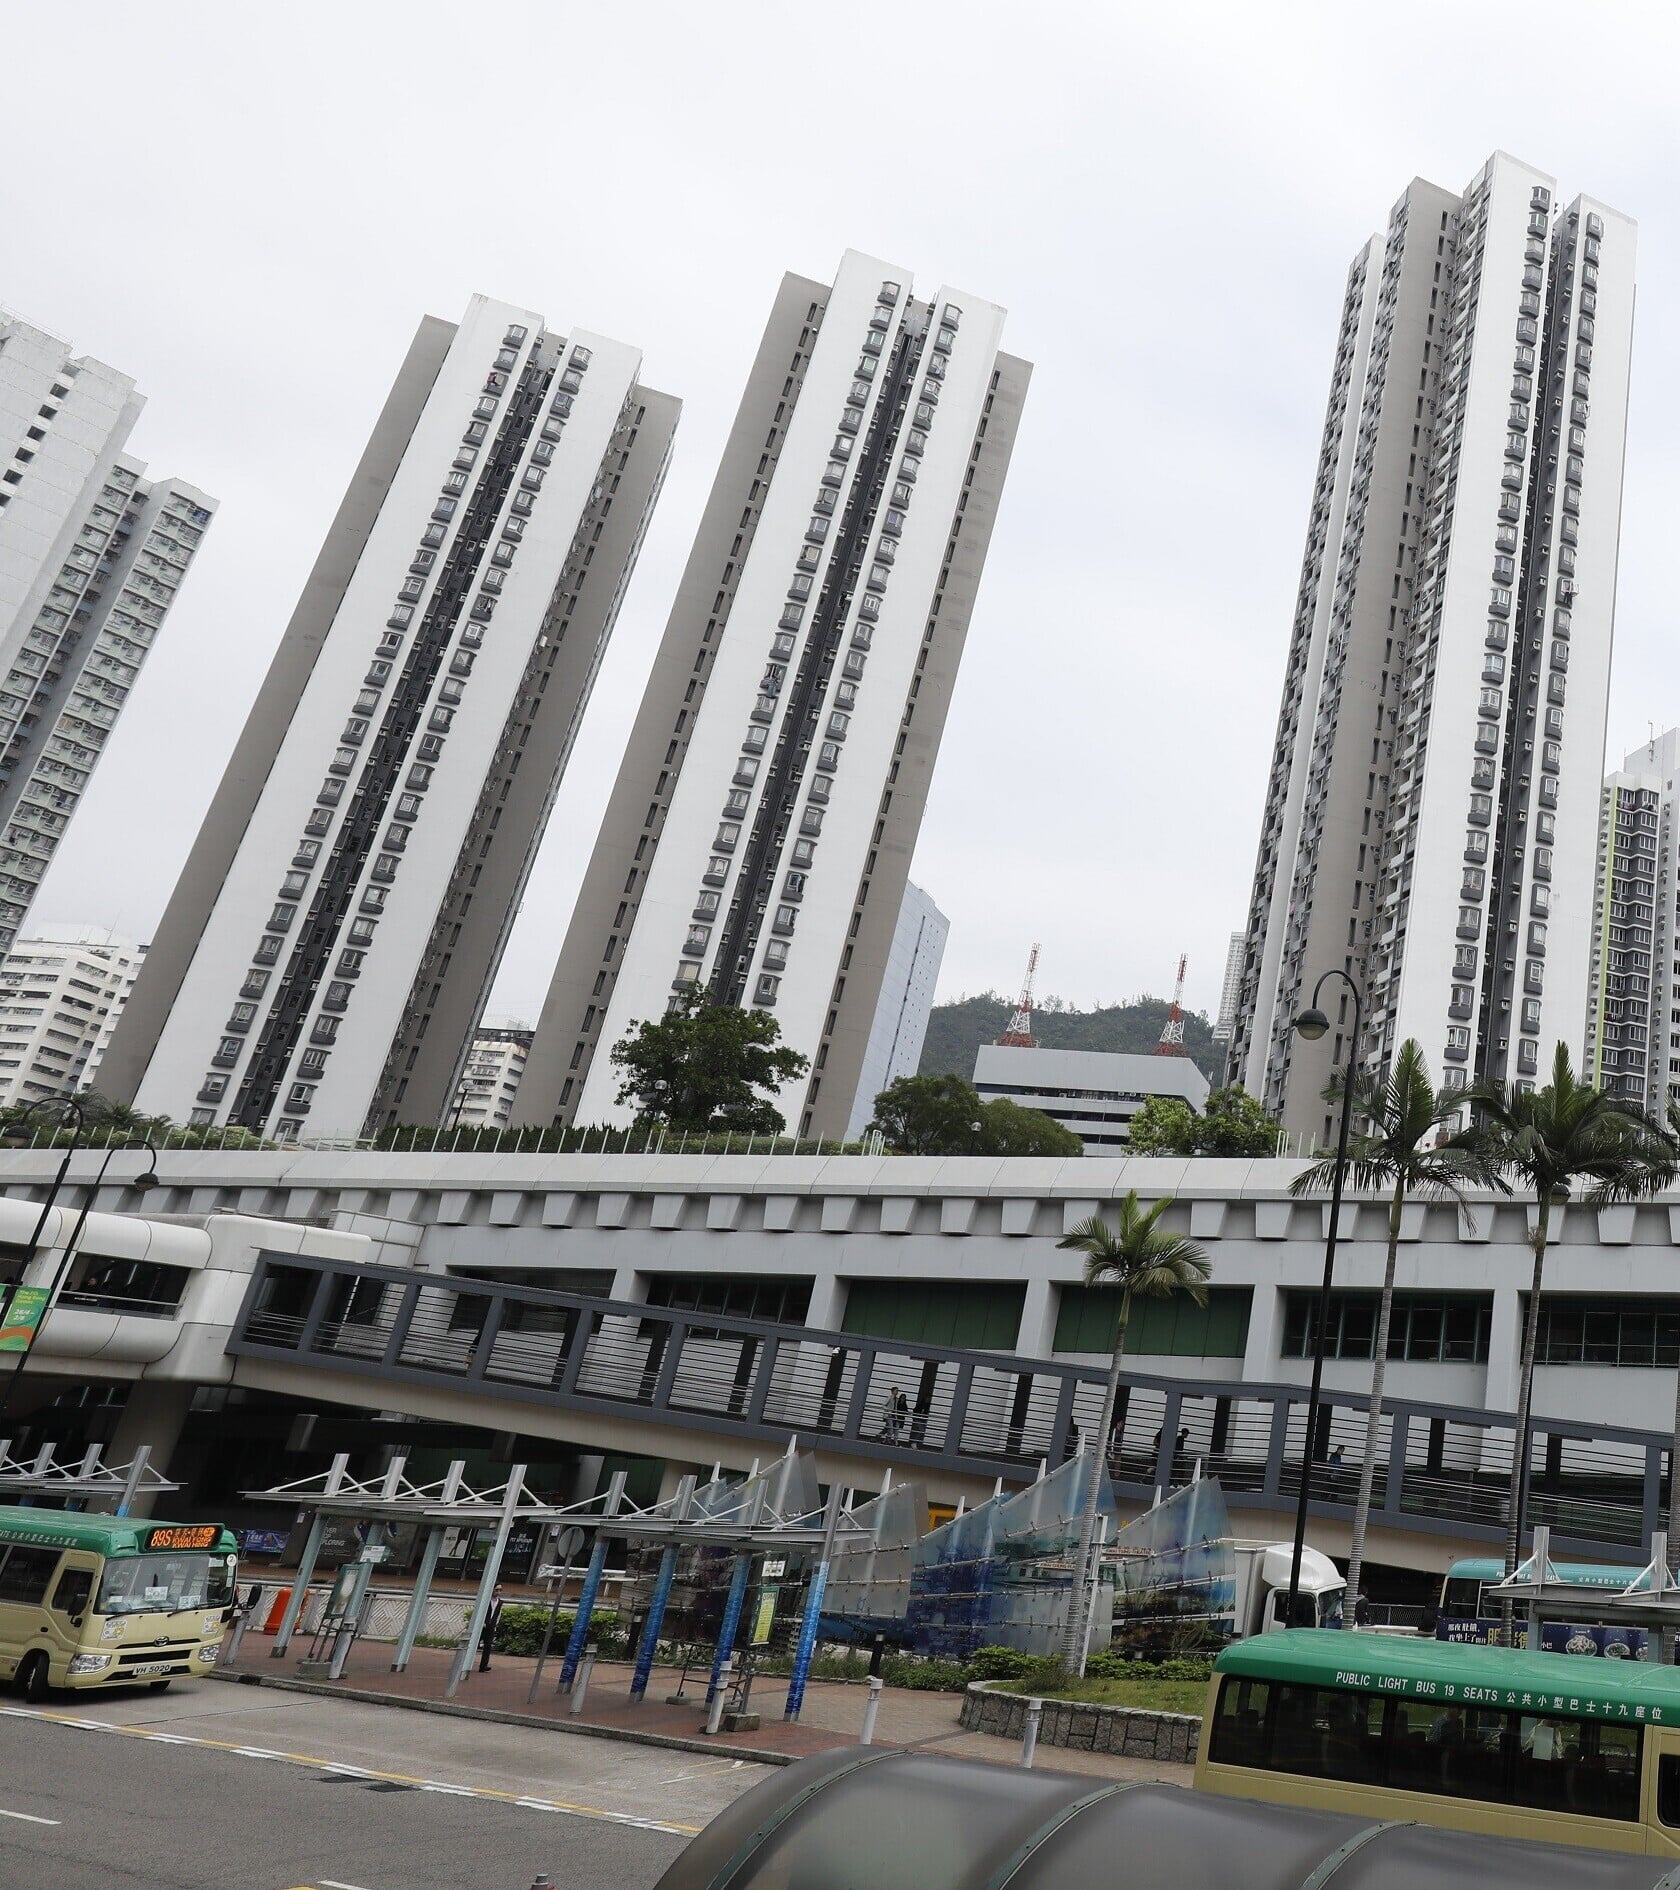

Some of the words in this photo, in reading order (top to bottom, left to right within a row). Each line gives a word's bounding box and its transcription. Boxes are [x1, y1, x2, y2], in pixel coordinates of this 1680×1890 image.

[150, 1530, 173, 1547] 89S
[148, 1664, 170, 1673] 5020
[1336, 1671, 1370, 1687] PUBLIC
[1378, 1676, 1408, 1691] LIGHT
[1416, 1680, 1436, 1694] BUS
[1444, 1685, 1455, 1697] 19
[1463, 1686, 1498, 1702] SEATS
[1506, 1691, 1662, 1720] 公共小型巴士十九座位
